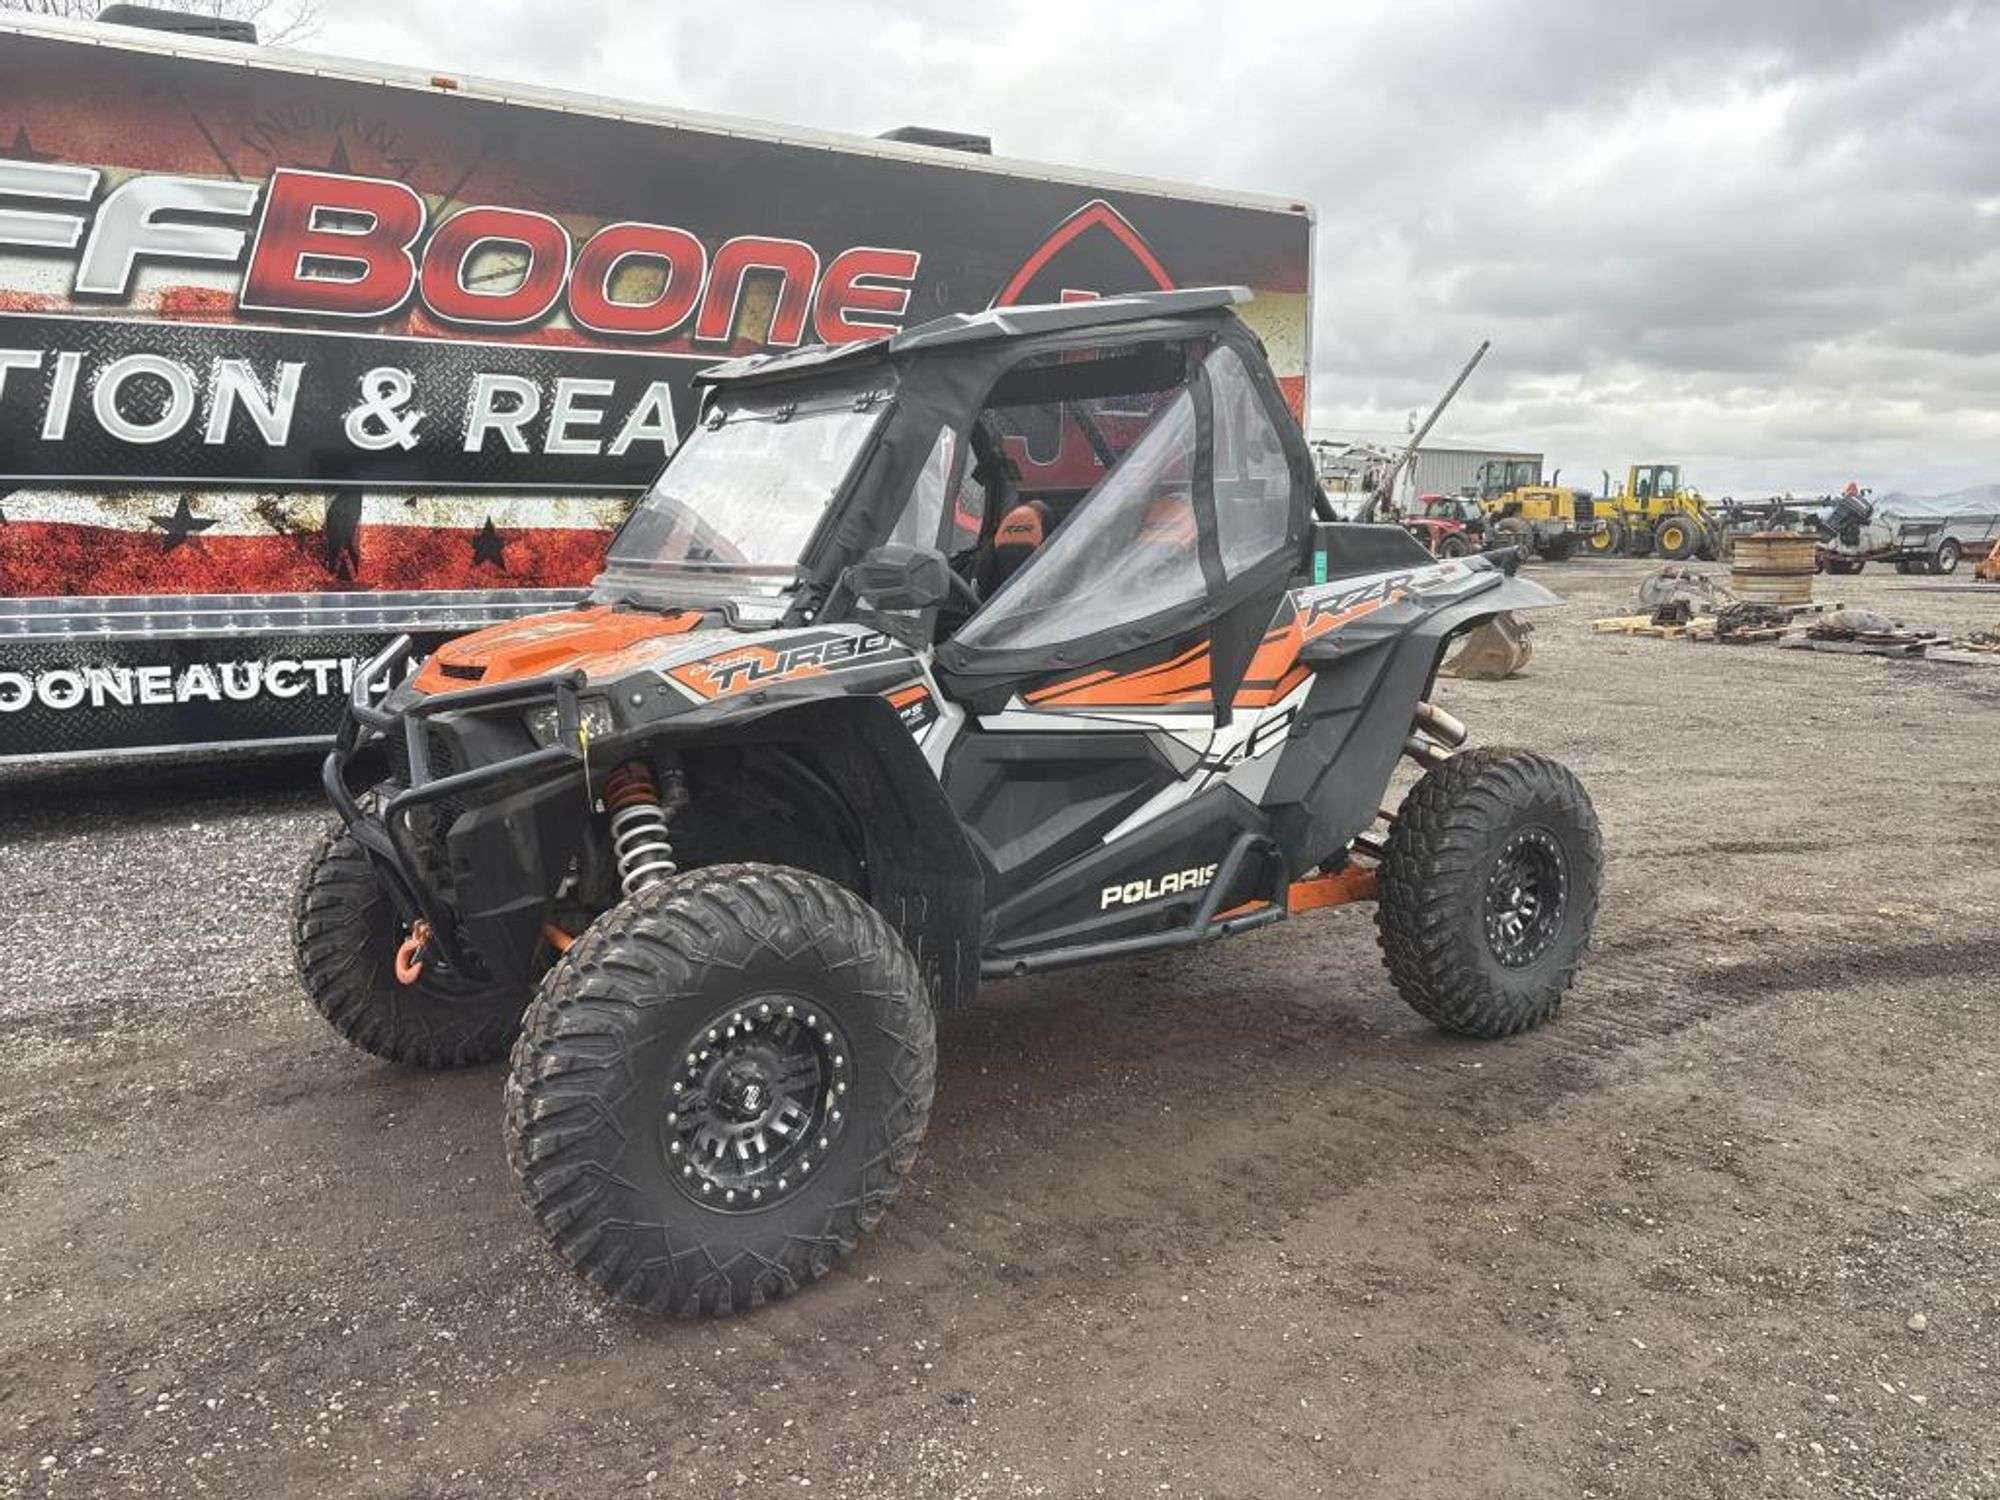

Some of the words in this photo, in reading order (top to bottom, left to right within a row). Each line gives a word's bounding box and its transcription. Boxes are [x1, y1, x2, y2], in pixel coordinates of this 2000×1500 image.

[344, 366, 425, 451] &
[463, 373, 718, 454] REA
[704, 633, 894, 693] TURBO
[1100, 862, 1219, 910] POLARIS
